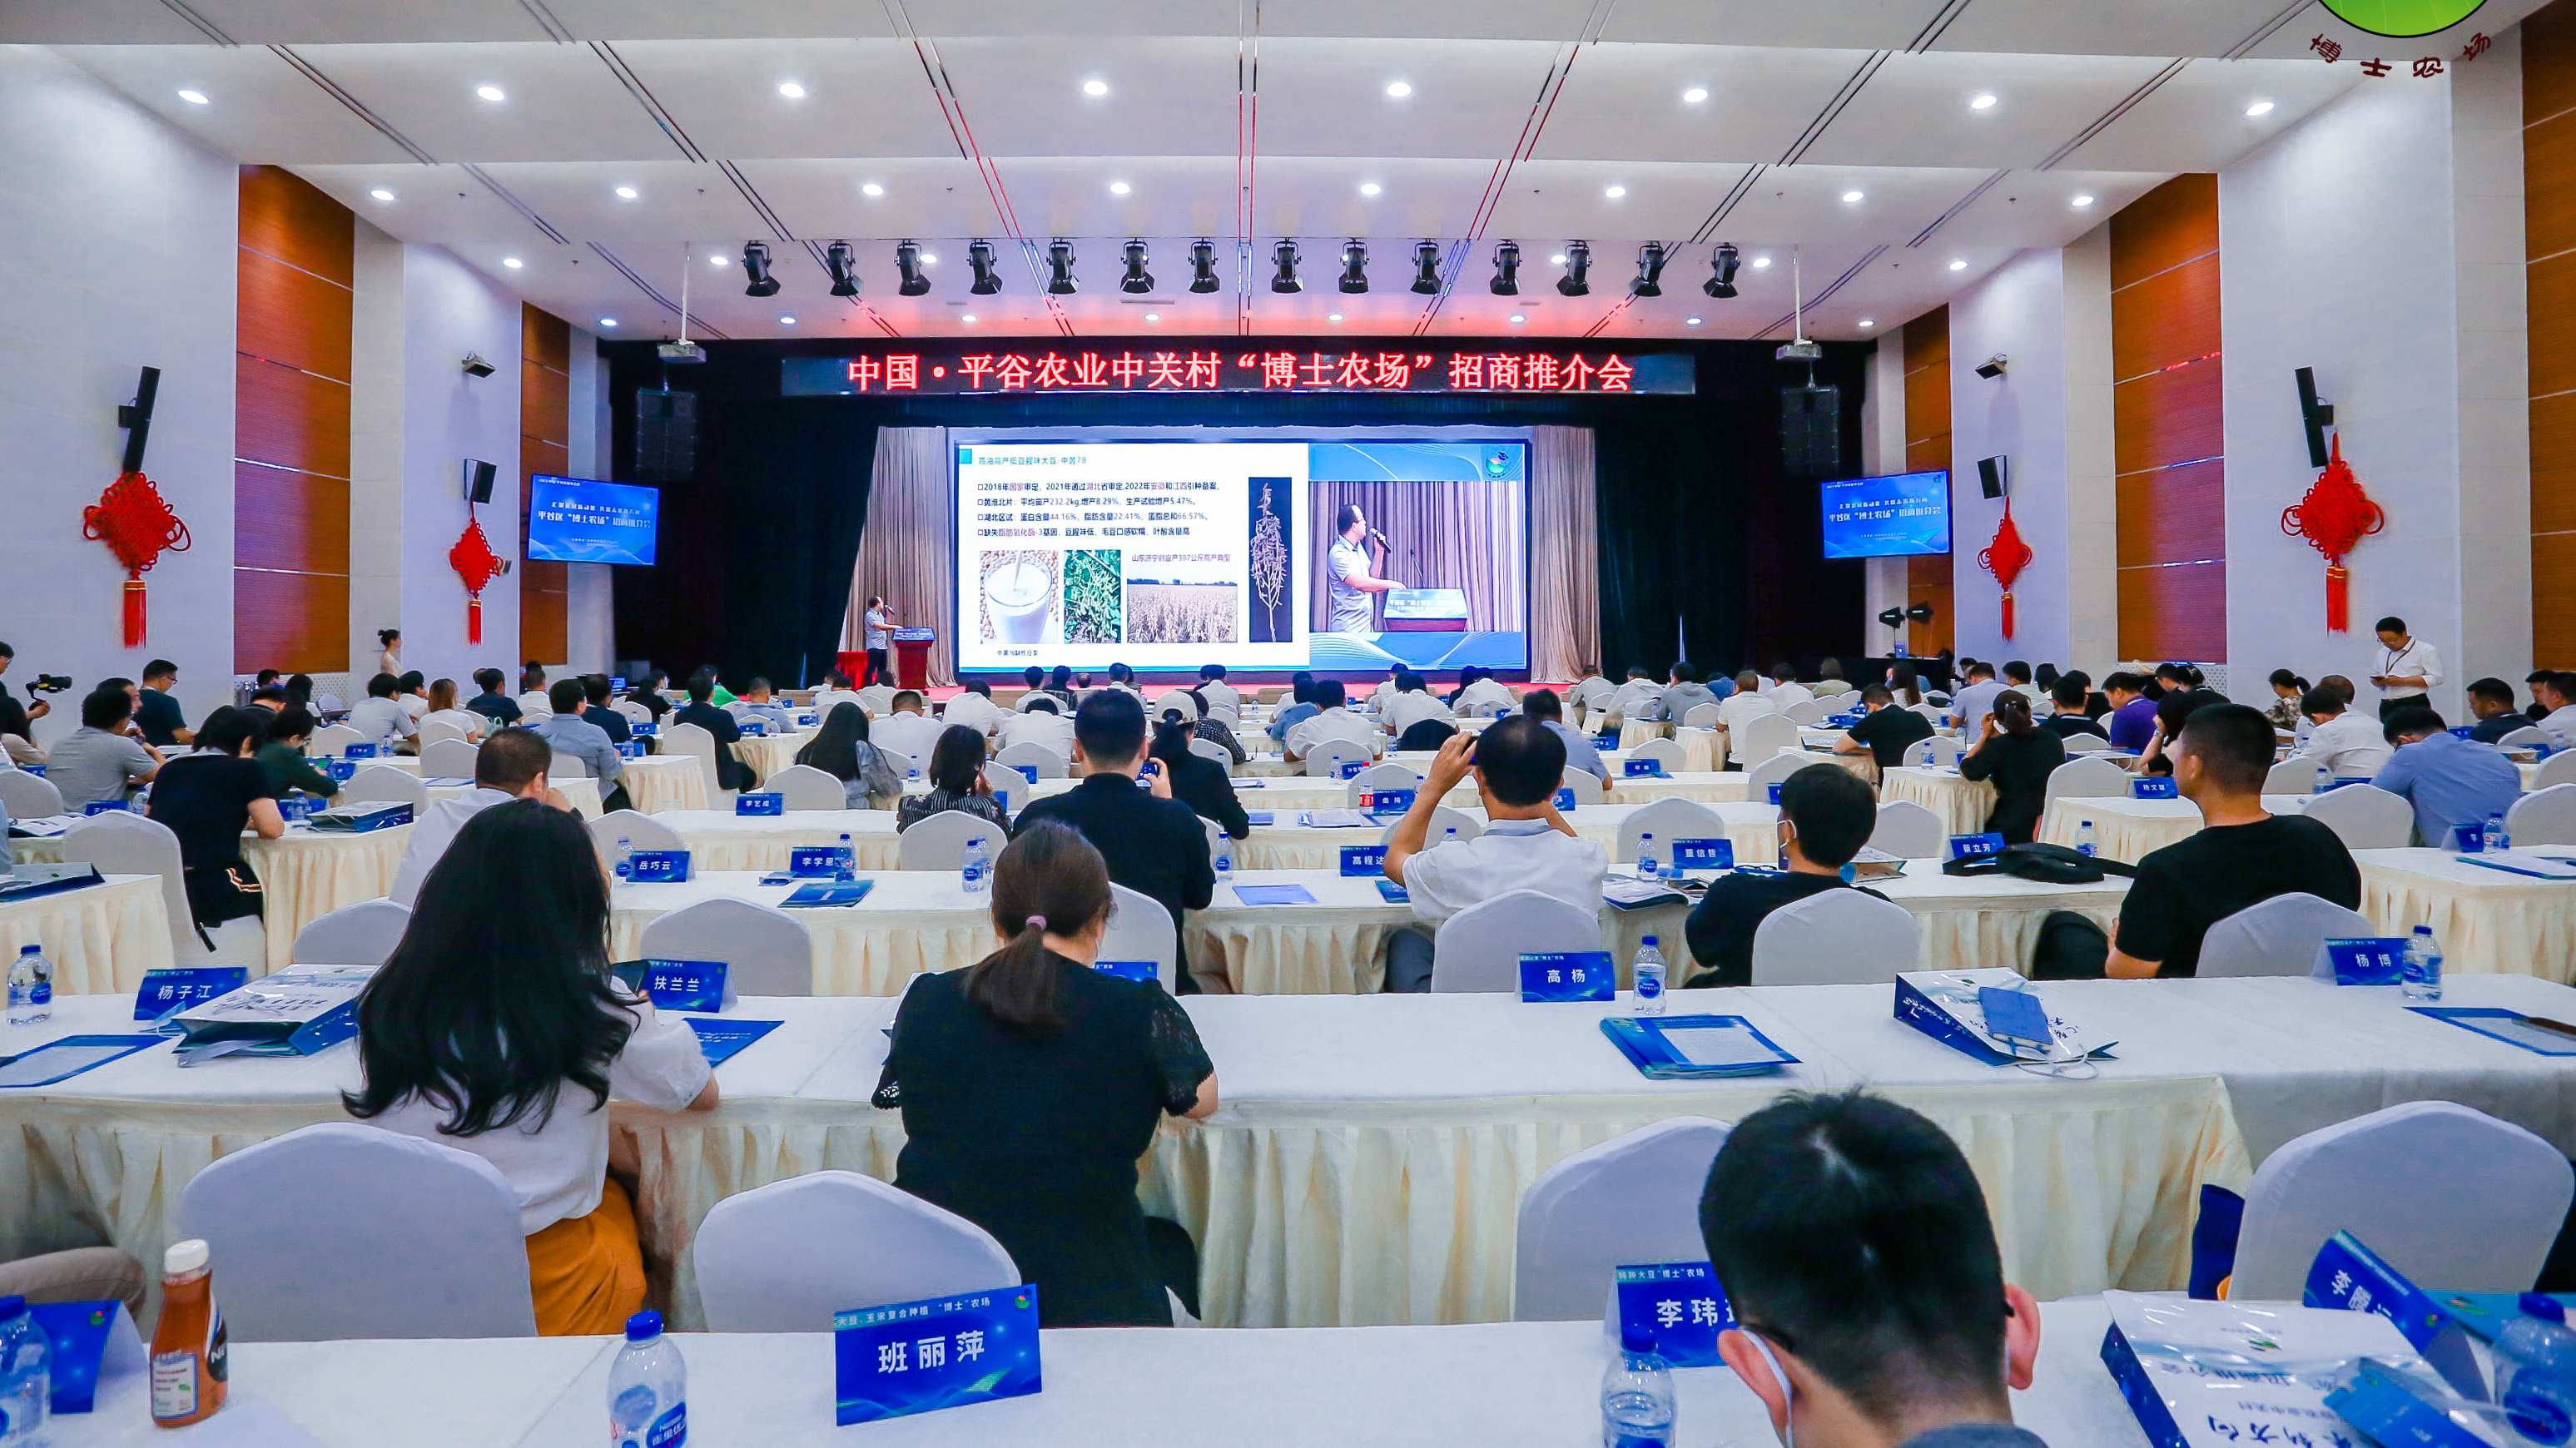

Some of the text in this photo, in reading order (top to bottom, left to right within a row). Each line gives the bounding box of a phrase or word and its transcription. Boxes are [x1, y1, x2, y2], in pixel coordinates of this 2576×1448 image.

[1963, 844, 1991, 853] 蔡立芳
[2356, 954, 2393, 968] 杨博
[653, 974, 700, 993] 扶兰兰
[1546, 969, 1586, 984] 高杨
[157, 984, 213, 1000] 杨子江
[877, 1330, 985, 1375] 班丽萍
